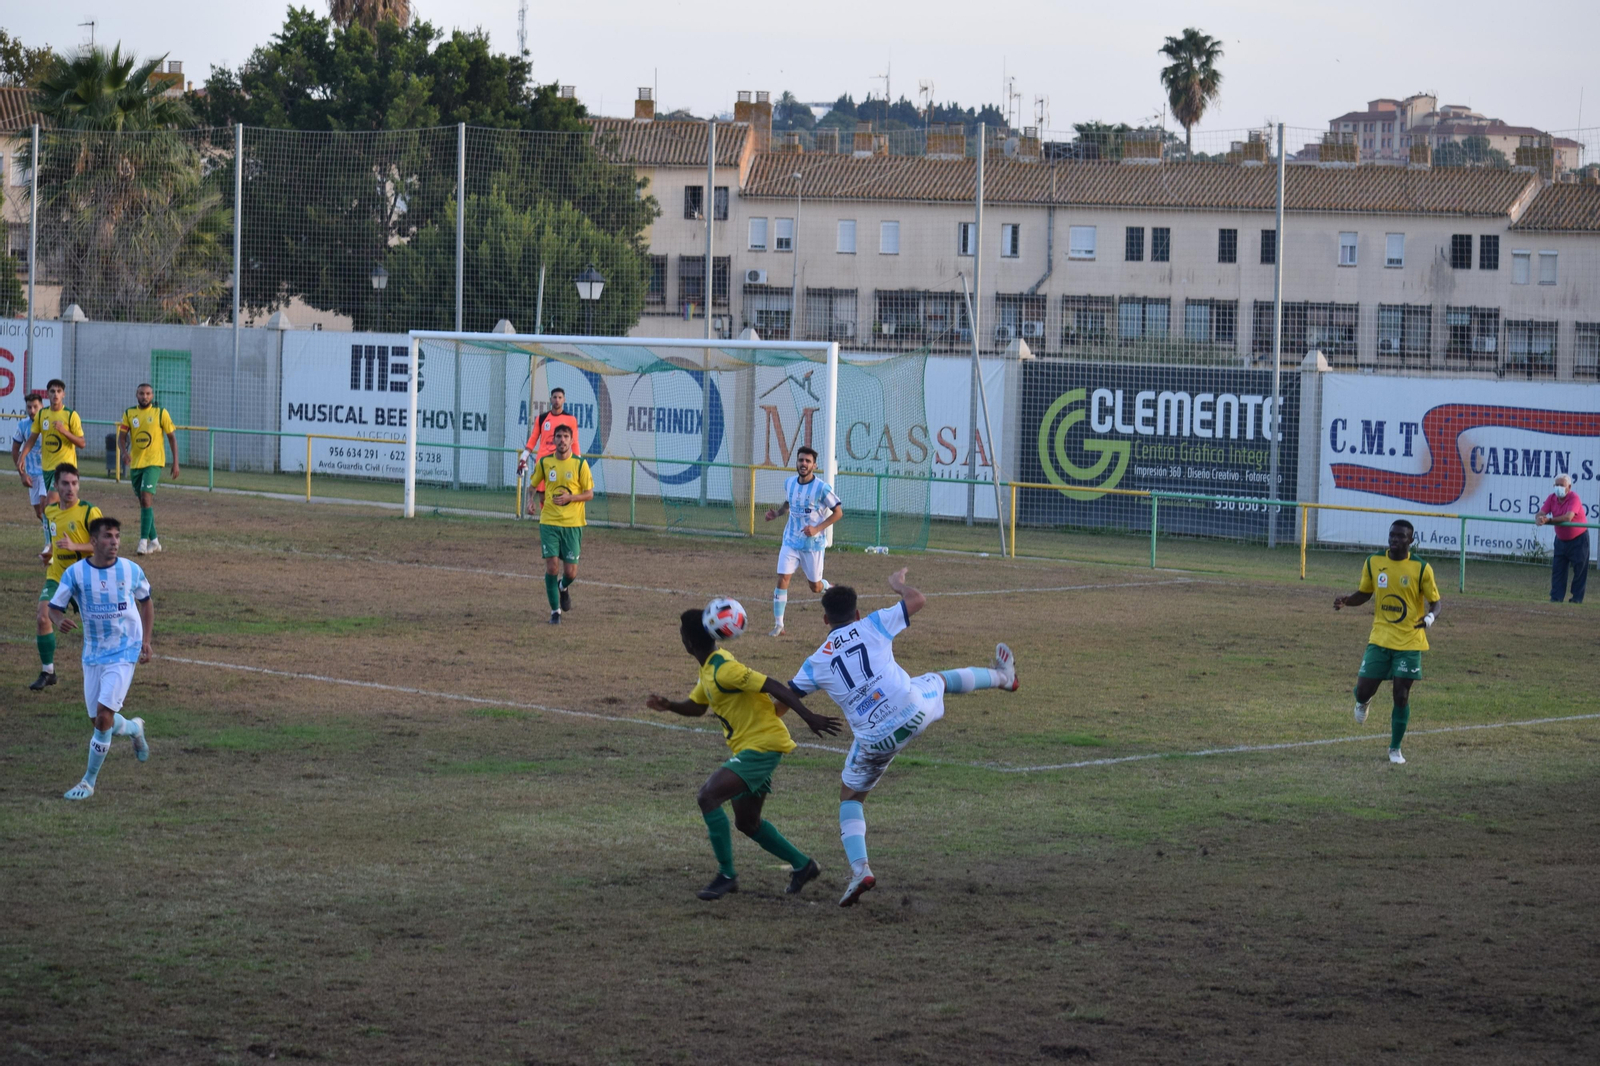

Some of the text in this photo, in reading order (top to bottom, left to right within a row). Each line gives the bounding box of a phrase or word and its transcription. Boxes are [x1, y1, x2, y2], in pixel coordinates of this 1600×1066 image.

[287, 402, 369, 425] MUSICAL
[626, 406, 705, 435] ACERINOX
[1090, 388, 1284, 442] CLEMENTE
[356, 431, 412, 442] ALGECIRA
[845, 420, 992, 467] CASSA
[1329, 417, 1419, 458] C.M.T
[330, 446, 344, 457] 956
[347, 448, 362, 459] 634
[364, 449, 379, 460] 291
[390, 451, 405, 461] 622
[426, 453, 442, 463] 238
[1134, 439, 1282, 470] Centro Gráfico Integrl
[337, 461, 363, 471] Guardia
[365, 463, 380, 472] Civil
[1134, 465, 1168, 479] Impresión
[1187, 467, 1211, 480] Diseño
[1212, 470, 1240, 482] Creativo
[1488, 492, 1522, 514] Los
[1430, 530, 1457, 545] Área
[1473, 535, 1513, 550] Fresno
[830, 642, 874, 690] 17
[873, 703, 891, 720] BAR
